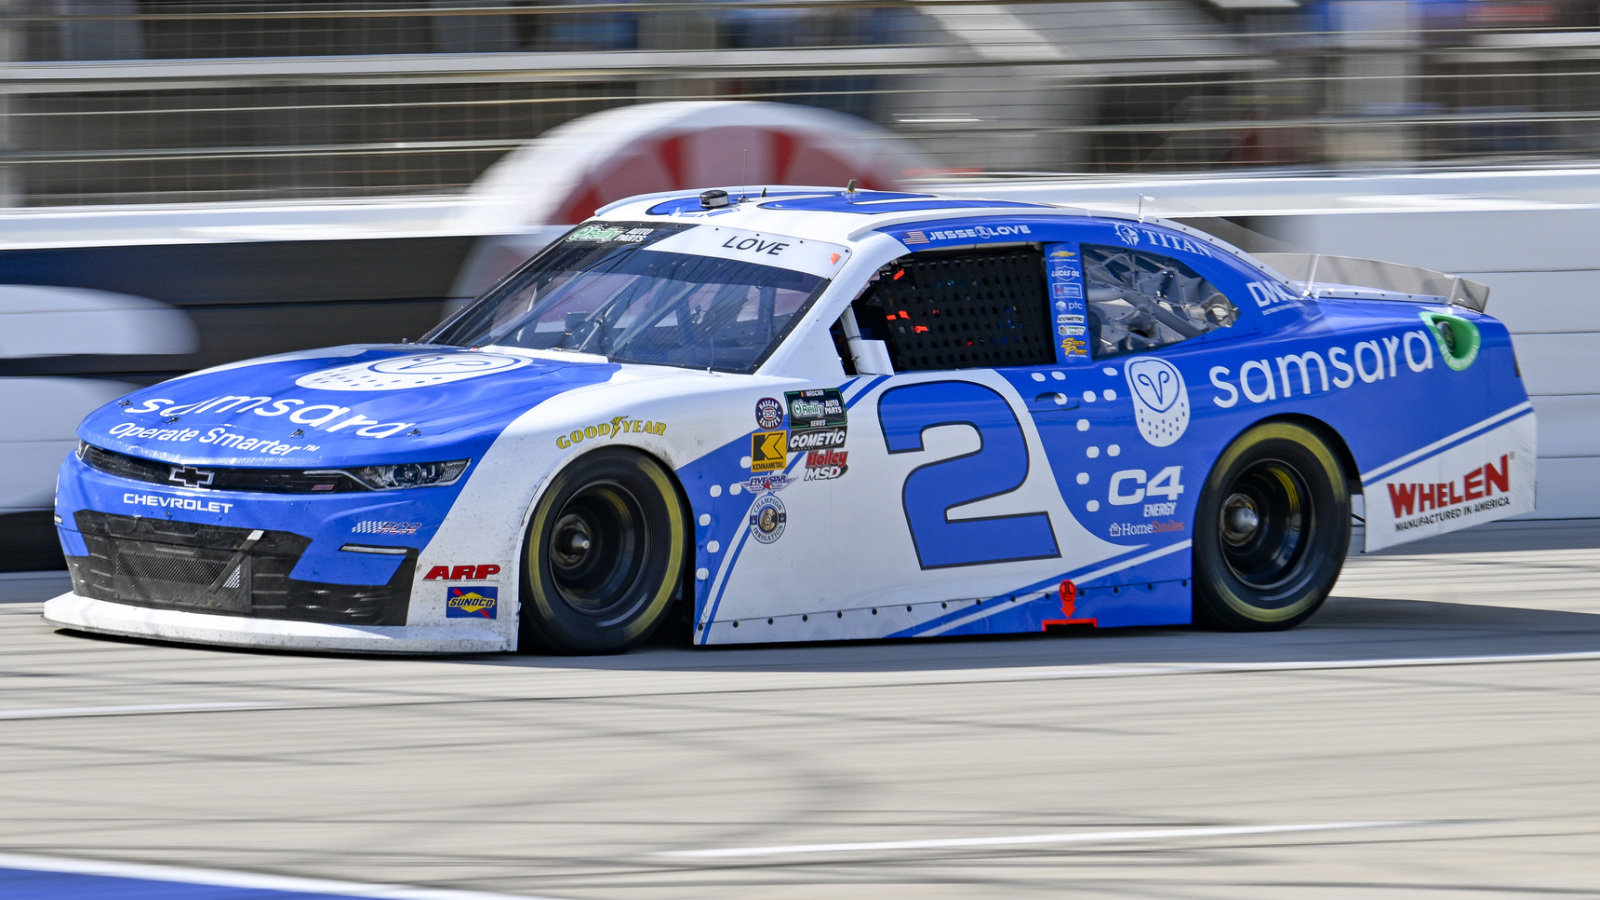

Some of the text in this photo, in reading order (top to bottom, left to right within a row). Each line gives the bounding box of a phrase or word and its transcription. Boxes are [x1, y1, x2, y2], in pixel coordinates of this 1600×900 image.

[929, 228, 977, 241] JESSE
[986, 225, 1031, 236] LOVE
[721, 235, 790, 256] LOVE
[1141, 229, 1213, 258] TITAN
[1051, 269, 1071, 277] LUCAS
[1068, 301, 1083, 310] ptc
[1208, 330, 1434, 409] samsara
[758, 399, 779, 410] NASCAR
[793, 401, 823, 416] O'Reilly
[825, 399, 840, 407] AUTO
[825, 407, 842, 415] PARTS
[124, 394, 416, 439] samsara
[760, 416, 781, 428] SALUTES
[763, 410, 776, 418] 250
[810, 419, 826, 427] SERIES
[109, 422, 200, 442] Operate
[556, 417, 667, 449] GOODYEAR
[790, 428, 845, 448] COMETIC
[752, 461, 784, 471] KENNAMETAL
[806, 449, 848, 468] Holley
[750, 475, 786, 486] FIVE STAR
[804, 466, 842, 481] MSD
[877, 379, 1062, 571] 2
[1108, 465, 1184, 506] C4
[123, 493, 233, 514] CHEVROLET
[753, 497, 783, 513] CHAMPION
[1143, 502, 1177, 517] ENERGY
[1395, 496, 1511, 532] MANUFACTURED IN AMERICA
[753, 525, 783, 541] IRRIGATION
[423, 564, 501, 580] ARP
[449, 598, 494, 608] SUNOCO
